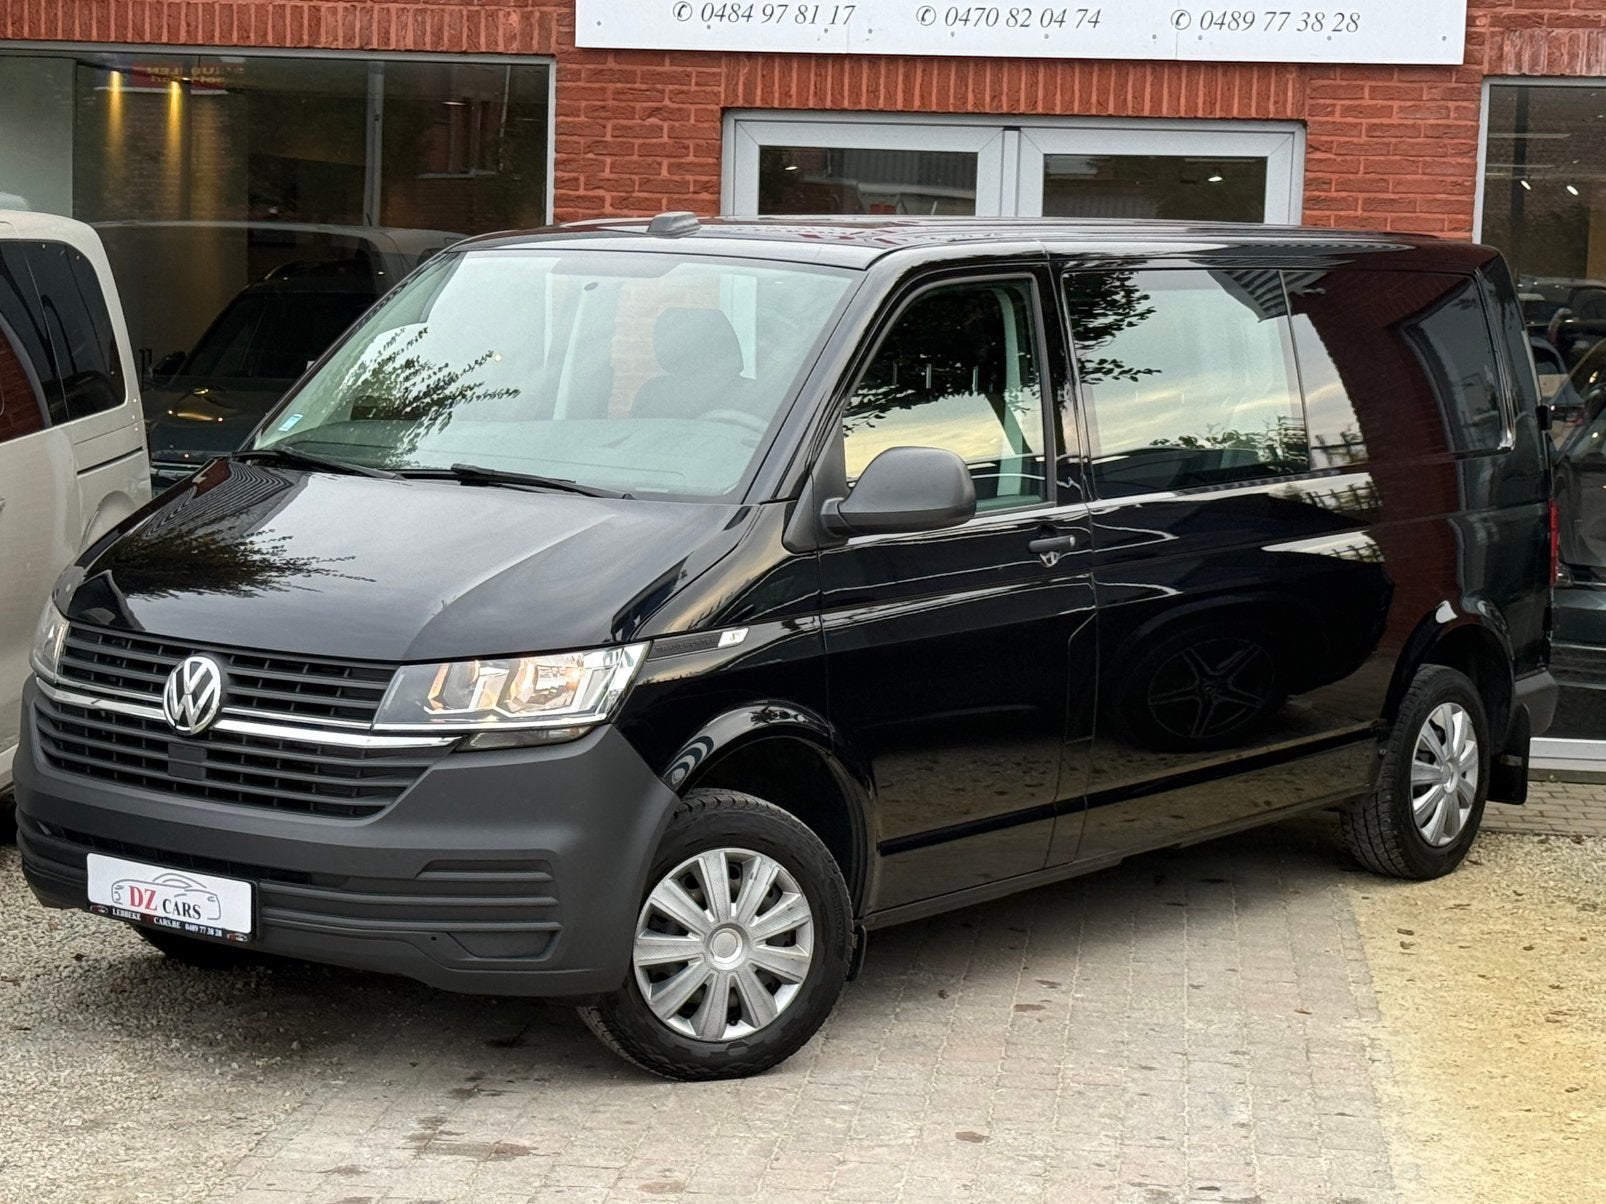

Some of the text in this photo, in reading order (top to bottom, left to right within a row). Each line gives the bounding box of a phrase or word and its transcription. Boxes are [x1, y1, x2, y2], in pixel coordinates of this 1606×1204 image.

[701, 2, 857, 25] 0484 97 81 17
[945, 7, 1101, 28] 0470 82 04 74
[1200, 11, 1360, 31] 0489 77 38 28
[129, 885, 201, 919] DZ CARS
